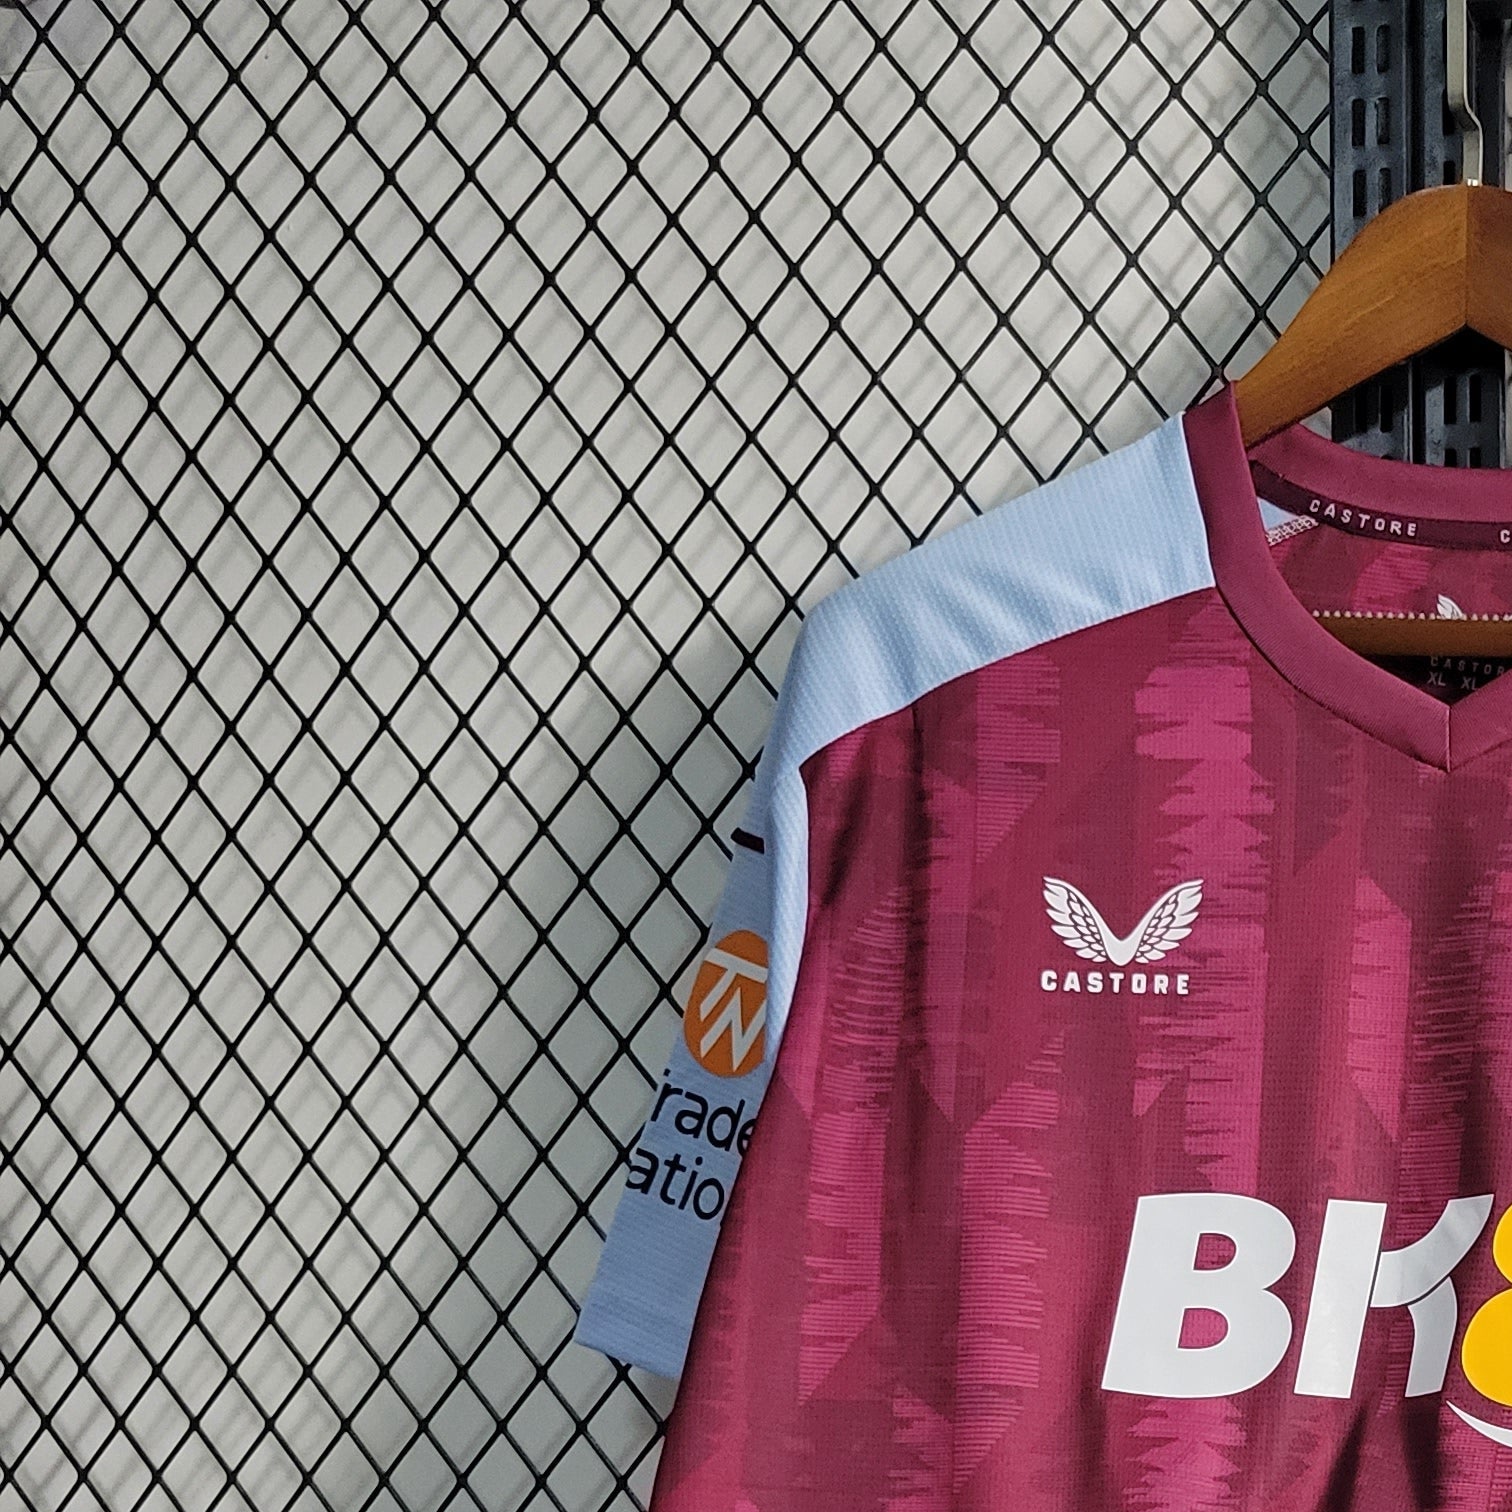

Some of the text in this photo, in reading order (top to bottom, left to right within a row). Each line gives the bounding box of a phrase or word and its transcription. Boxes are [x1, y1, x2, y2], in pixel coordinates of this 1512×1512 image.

[1309, 499, 1417, 537] CASTORE
[1427, 671, 1478, 690] XL XL
[1430, 655, 1505, 676] CASTOR
[1041, 969, 1190, 995] CASTORE
[650, 1068, 756, 1157] rade
[625, 1147, 725, 1220] atio
